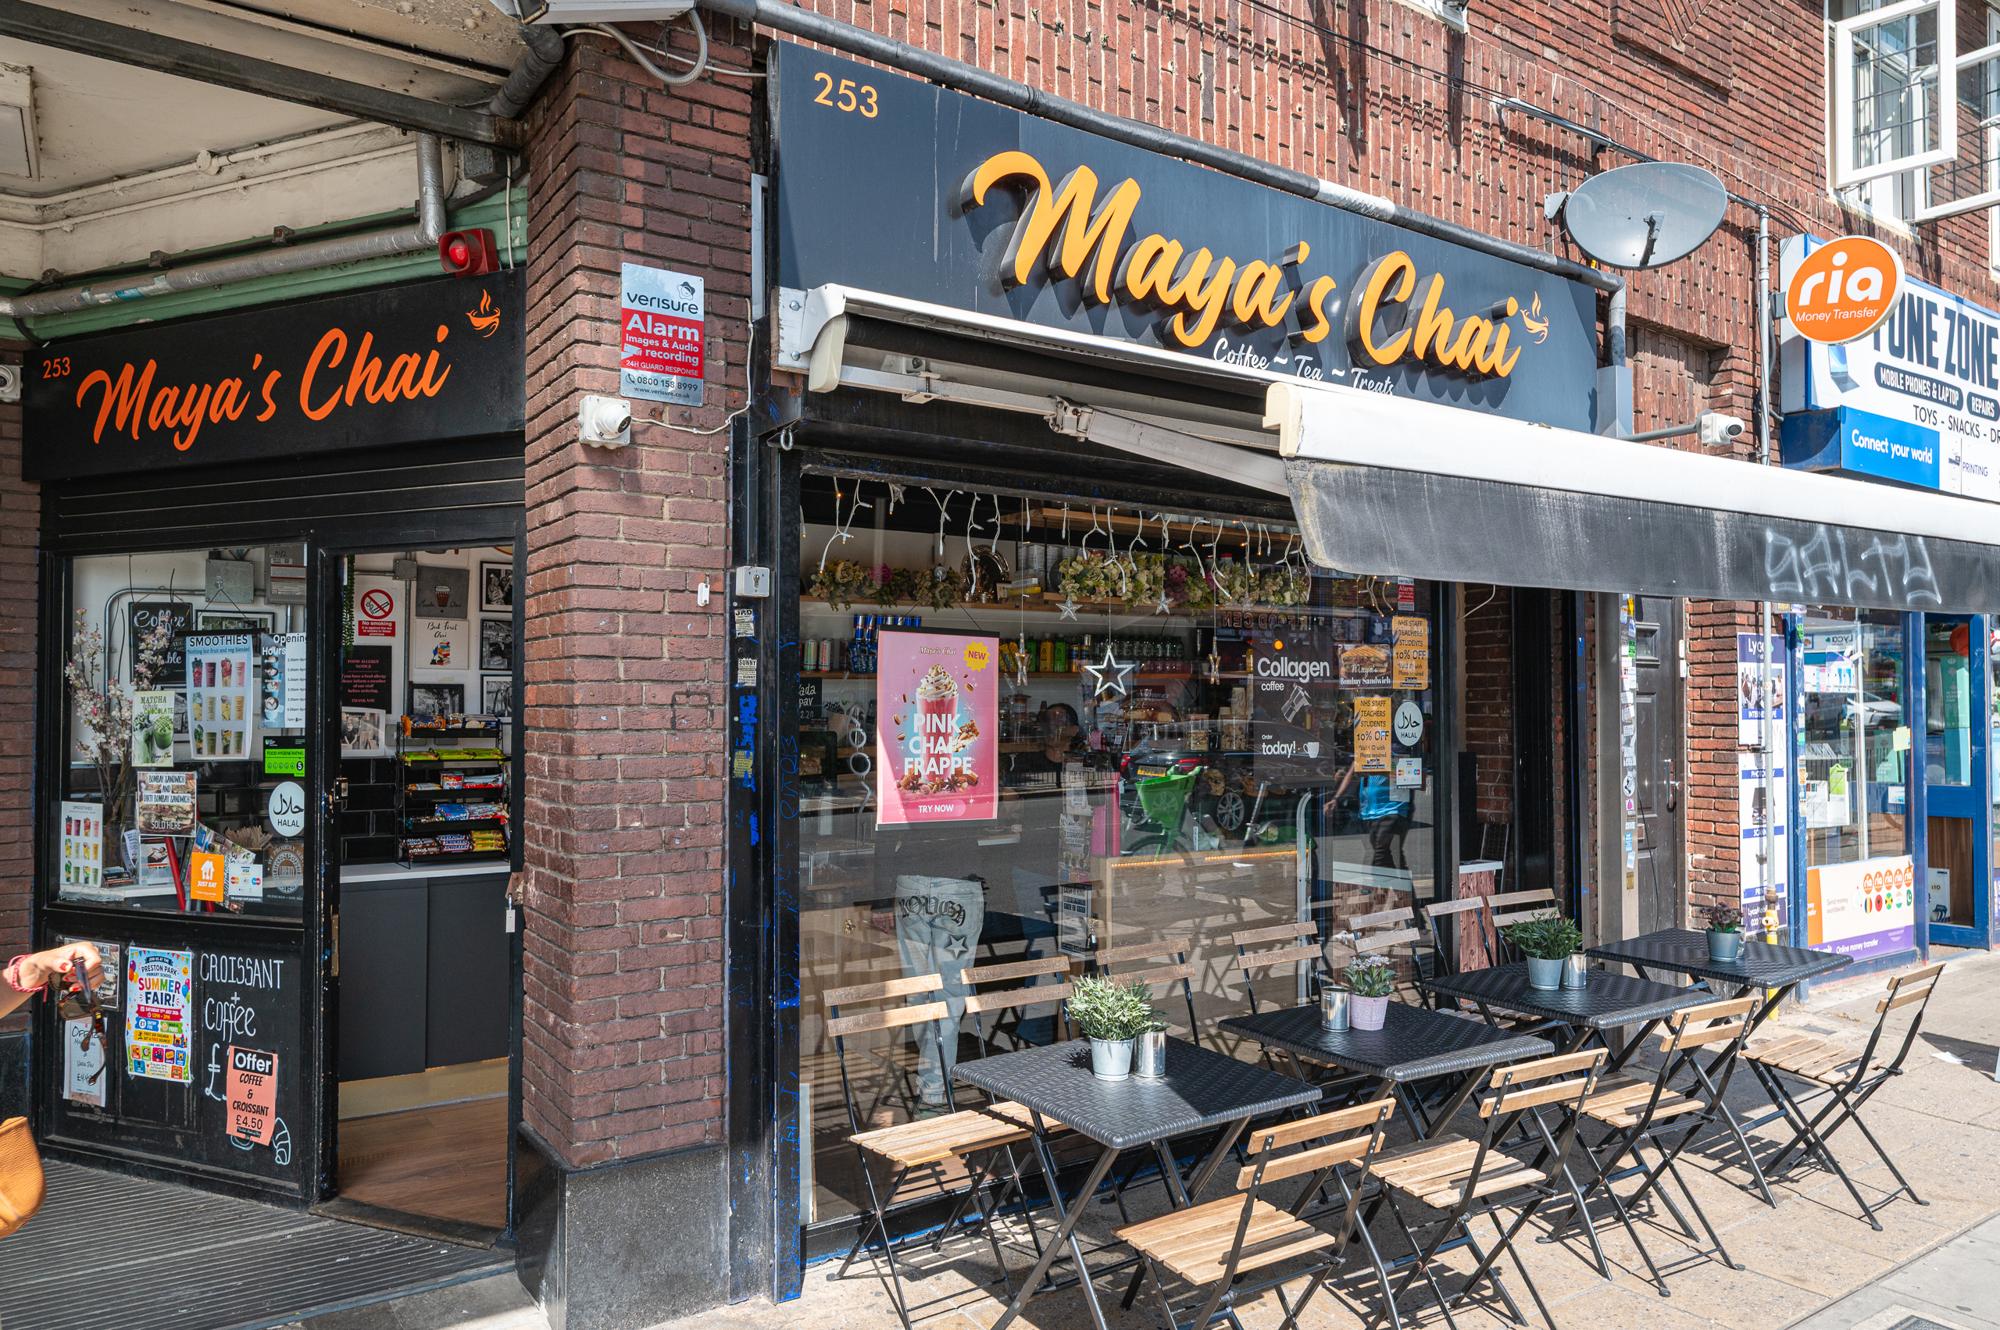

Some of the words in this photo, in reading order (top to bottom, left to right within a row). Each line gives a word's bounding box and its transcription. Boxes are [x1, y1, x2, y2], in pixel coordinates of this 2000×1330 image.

[813, 71, 879, 118] 253
[966, 150, 1337, 347] Maya's
[1354, 250, 1523, 378] Chai
[1798, 251, 1884, 307] ria
[626, 292, 699, 315] verisure
[1796, 311, 1831, 322] Money
[1833, 307, 1879, 320] Transfer
[626, 313, 700, 342] Alarm
[625, 333, 659, 347] Images
[662, 338, 670, 348] &
[672, 339, 699, 353] Audio
[1944, 306, 2000, 391] ZONE
[645, 348, 699, 367] recording
[42, 356, 72, 380] 253
[626, 360, 640, 369] 24H
[641, 362, 664, 371] GUARD
[665, 365, 699, 376] RESPONSE
[1213, 337, 1271, 371] Coffee
[1294, 355, 1324, 382] Tea
[1351, 367, 1395, 397] Treats
[76, 352, 283, 452] Maya's
[300, 325, 452, 422] Chai
[636, 376, 659, 387] 0800
[677, 382, 698, 392] 8999
[1880, 366, 1905, 390] MOBILE
[1905, 374, 1931, 398] PHONES
[1931, 382, 1938, 400] &
[1938, 384, 1960, 407] LAPTOP
[1971, 396, 1996, 418] REPAIRS
[1912, 404, 1938, 426] TOYS
[1948, 415, 1981, 439] SNACKS
[1851, 429, 1889, 453] Connect
[1889, 443, 1910, 460] your
[1910, 445, 1933, 465] world
[1961, 461, 1989, 477] PRINTING
[189, 635, 248, 647] SMOOTHIES
[273, 633, 306, 647] Openin
[262, 646, 287, 656] Hours
[968, 650, 987, 660] NEW
[1396, 651, 1411, 660] 10%
[1412, 650, 1427, 660] OFF
[1257, 657, 1330, 684] Collagen
[1261, 681, 1285, 691] coffee
[1362, 676, 1392, 686] Sandwich
[140, 696, 167, 705] MATCHA
[913, 714, 963, 734] PINK
[1397, 711, 1421, 729] حلال
[1356, 731, 1372, 741] 10%
[1374, 730, 1390, 741] OFF
[1261, 741, 1296, 758] today!
[903, 756, 973, 776] FRAPPE
[272, 792, 305, 816] حلال
[917, 803, 934, 814] TRY
[934, 803, 955, 813] NOW
[151, 820, 165, 830] SOLD
[166, 820, 182, 831] HERE
[277, 818, 300, 828] HALAL
[141, 964, 164, 973] PRESTON
[164, 968, 178, 977] PARK
[200, 952, 284, 989] CROISSANT
[138, 977, 182, 995] SUMMER
[144, 991, 176, 1007] FAIR!
[205, 996, 256, 1043] Coffee
[234, 1052, 272, 1073] Offer
[239, 1073, 263, 1087] COFFEE
[247, 1088, 254, 1100] &
[232, 1100, 270, 1117] CROISSANT
[235, 1114, 264, 1130] £4.50
